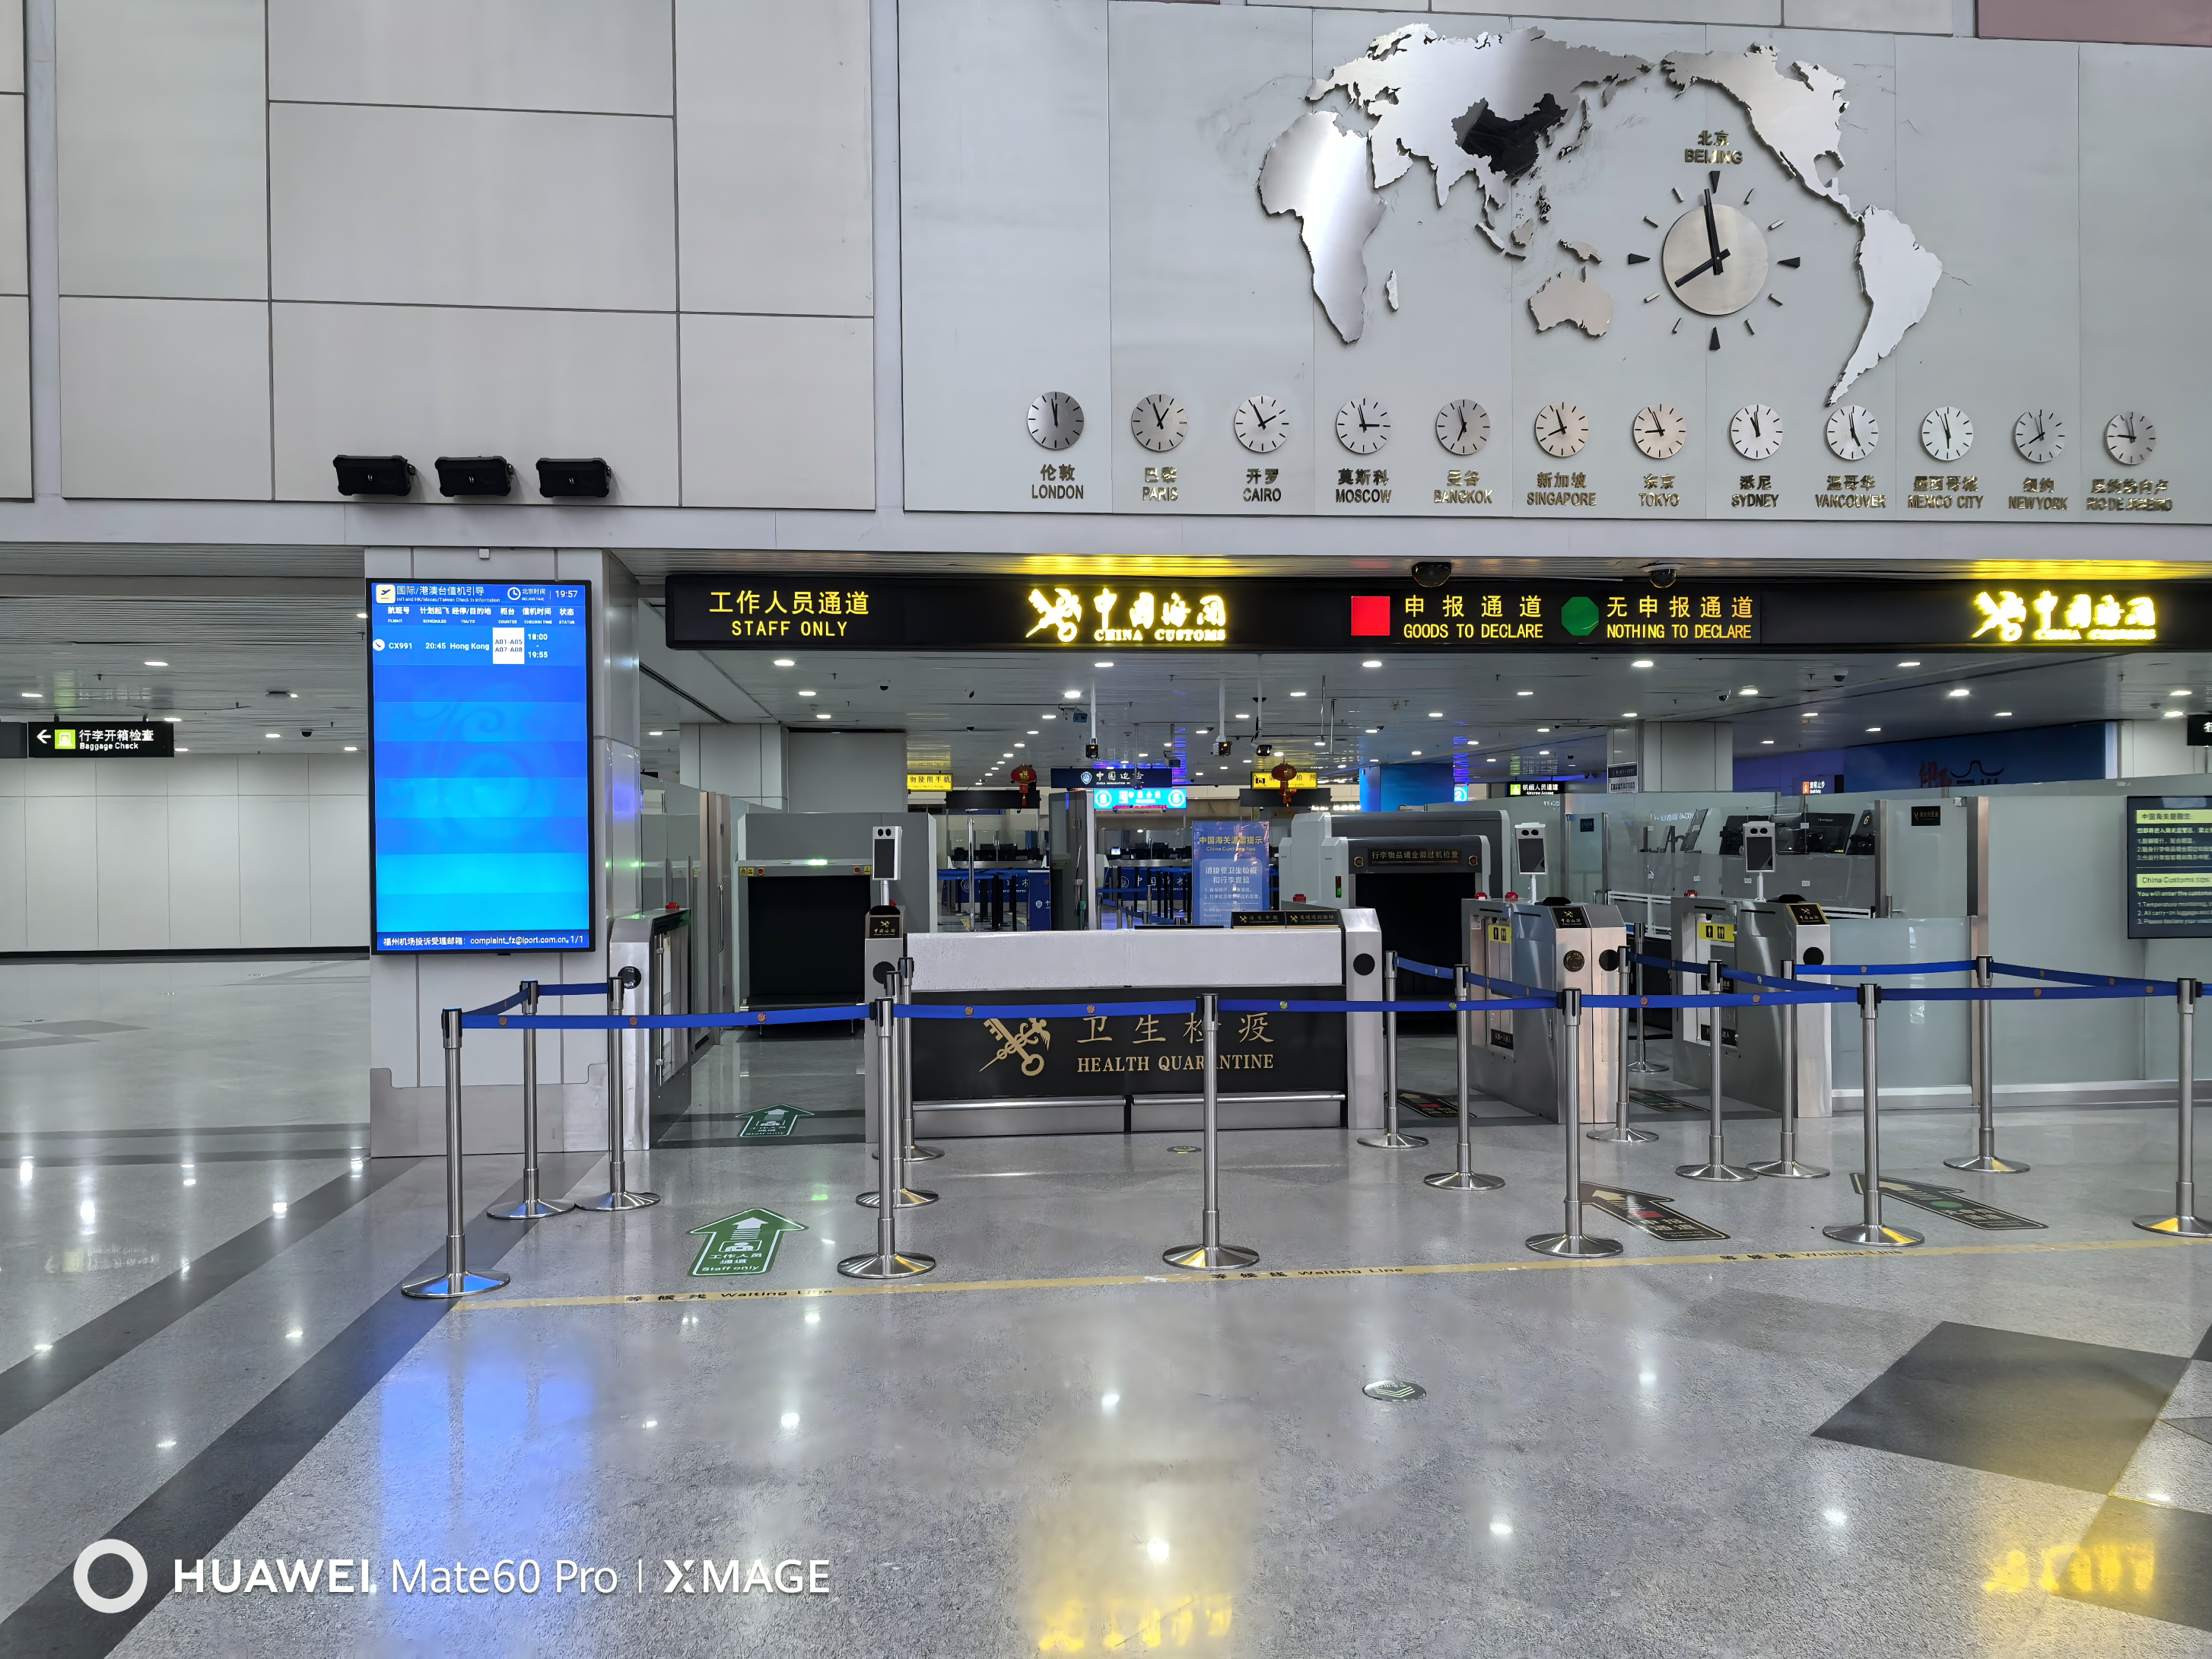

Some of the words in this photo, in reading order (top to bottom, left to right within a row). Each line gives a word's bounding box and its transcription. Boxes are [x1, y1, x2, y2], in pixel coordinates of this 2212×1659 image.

[1698, 129, 1730, 147] 北京
[1684, 148, 1743, 164] BEIJING
[1040, 464, 1076, 481] 伦敦
[1145, 466, 1178, 483] 巴黎
[1246, 468, 1279, 485] 开罗
[1338, 469, 1390, 486] 莫斯科
[1447, 469, 1479, 487] 曼谷
[1537, 472, 1587, 488] 新加坡
[1740, 475, 1771, 490] 悉尼
[1826, 475, 1876, 491] 温哥华
[1031, 485, 1084, 499] LONDON
[1143, 487, 1178, 501] PARIS
[1242, 488, 1282, 502] CAIRO
[1336, 488, 1392, 504] MOSCOW
[1434, 489, 1493, 504] BANGKOK
[1527, 492, 1597, 506] SINGAPORE
[1639, 493, 1680, 507] TOKYO
[1731, 494, 1779, 508] SYDNEY
[1815, 494, 1886, 508] VANCOUVER
[1907, 494, 1953, 509] MEXICO
[1956, 495, 1984, 509] CITY
[397, 586, 485, 596] 国际/港澳台值机引导
[709, 590, 869, 615] 工作人员通道
[1406, 595, 1542, 618] 申报通道
[1607, 595, 1753, 618] 无申报通道
[388, 606, 410, 615] 航班号
[420, 606, 450, 615] 计划起飞
[452, 606, 491, 615] 经停/目的地
[501, 607, 515, 616] 柜台
[522, 607, 551, 616] 值机时间
[560, 608, 574, 616] 状态
[732, 621, 790, 637] STAFF
[801, 621, 847, 637] ONLY
[1094, 629, 1143, 641] CHINA
[1154, 629, 1226, 641] CUSTOMS
[1403, 624, 1448, 639] GOODS
[1457, 624, 1475, 639] TO
[1481, 624, 1543, 639] DECLARE
[1607, 624, 1664, 639] NOTHING
[1671, 624, 1689, 639] TO
[1694, 624, 1752, 639] DECLARE
[450, 643, 469, 651] Hong
[471, 643, 490, 651] Kong
[79, 729, 154, 742] 行李开箱检查
[79, 742, 113, 751] Baggage
[1864, 815, 1870, 825] 6
[570, 935, 583, 943] 1/1
[1077, 1056, 1150, 1073] HEALTH
[1158, 1054, 1273, 1071] QUARNTINE
